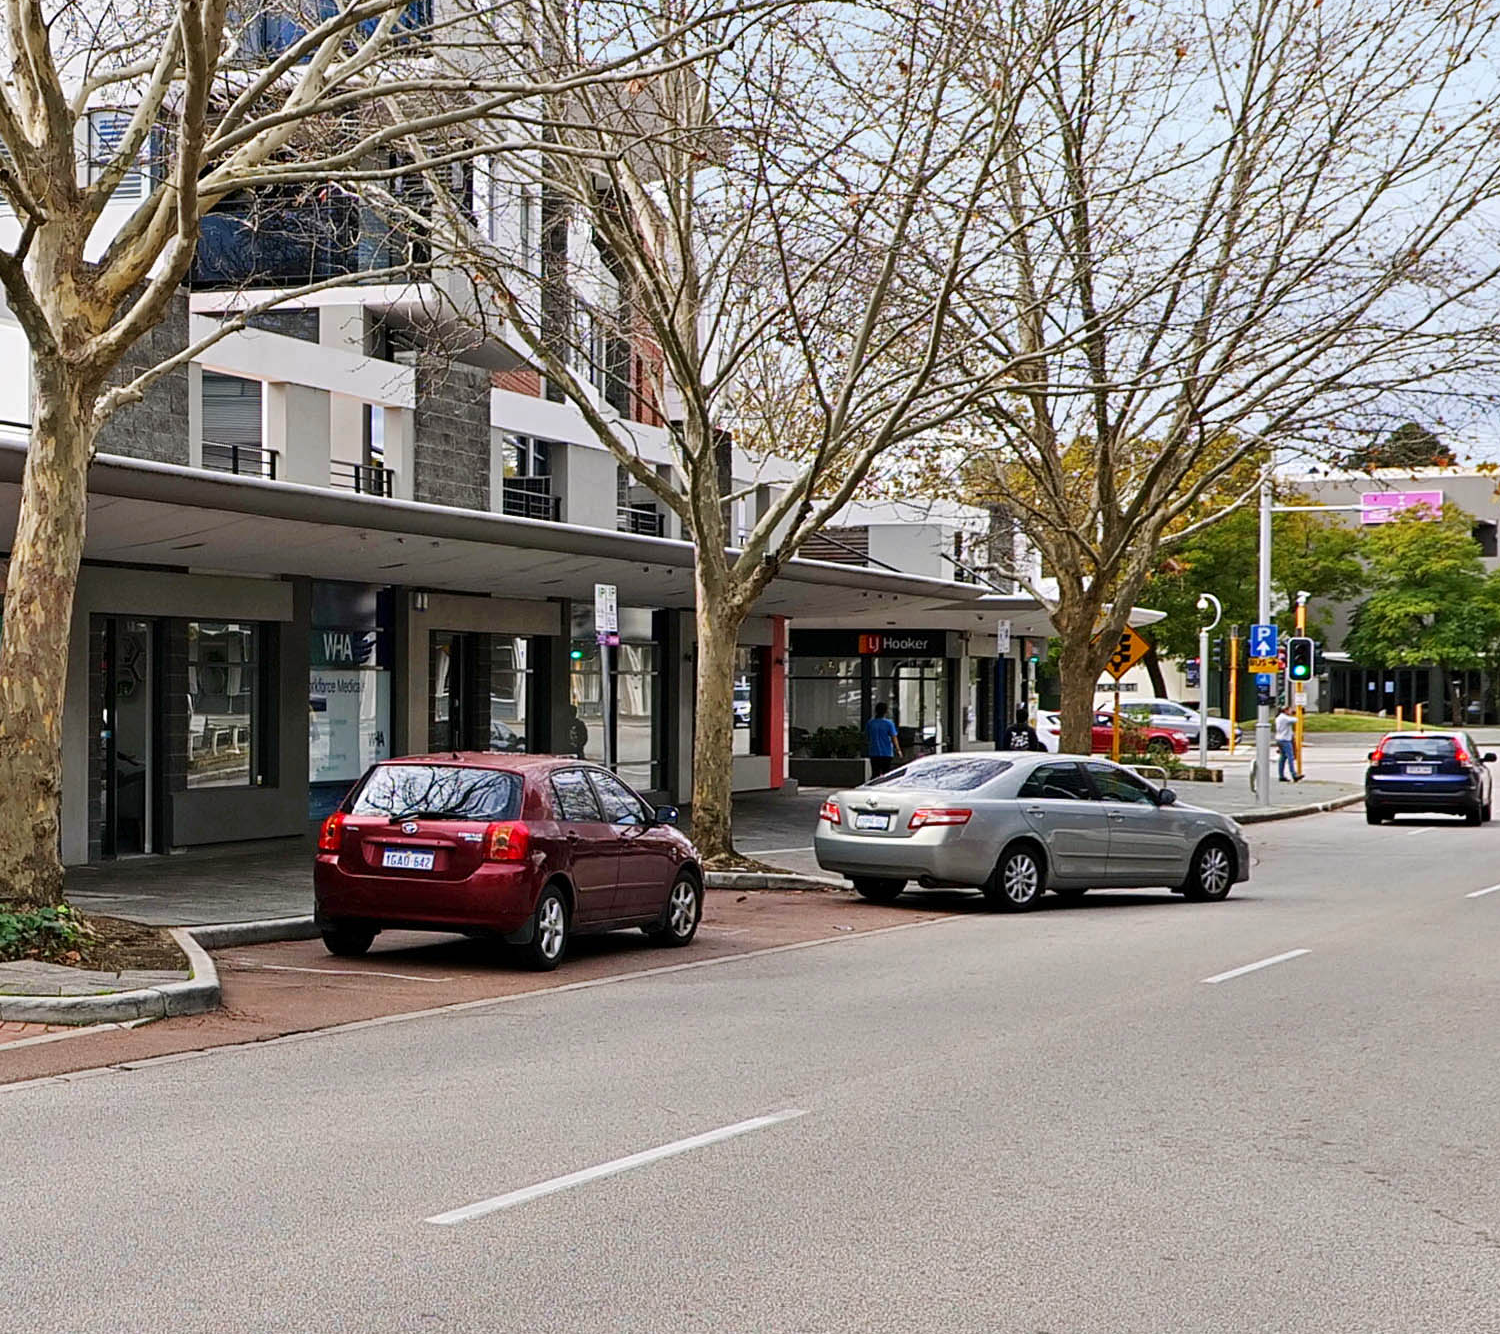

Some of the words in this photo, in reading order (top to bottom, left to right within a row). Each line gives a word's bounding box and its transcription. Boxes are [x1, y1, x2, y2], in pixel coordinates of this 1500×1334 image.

[1258, 627, 1271, 642] P
[323, 632, 353, 661] WHA
[883, 636, 929, 650] Hooker
